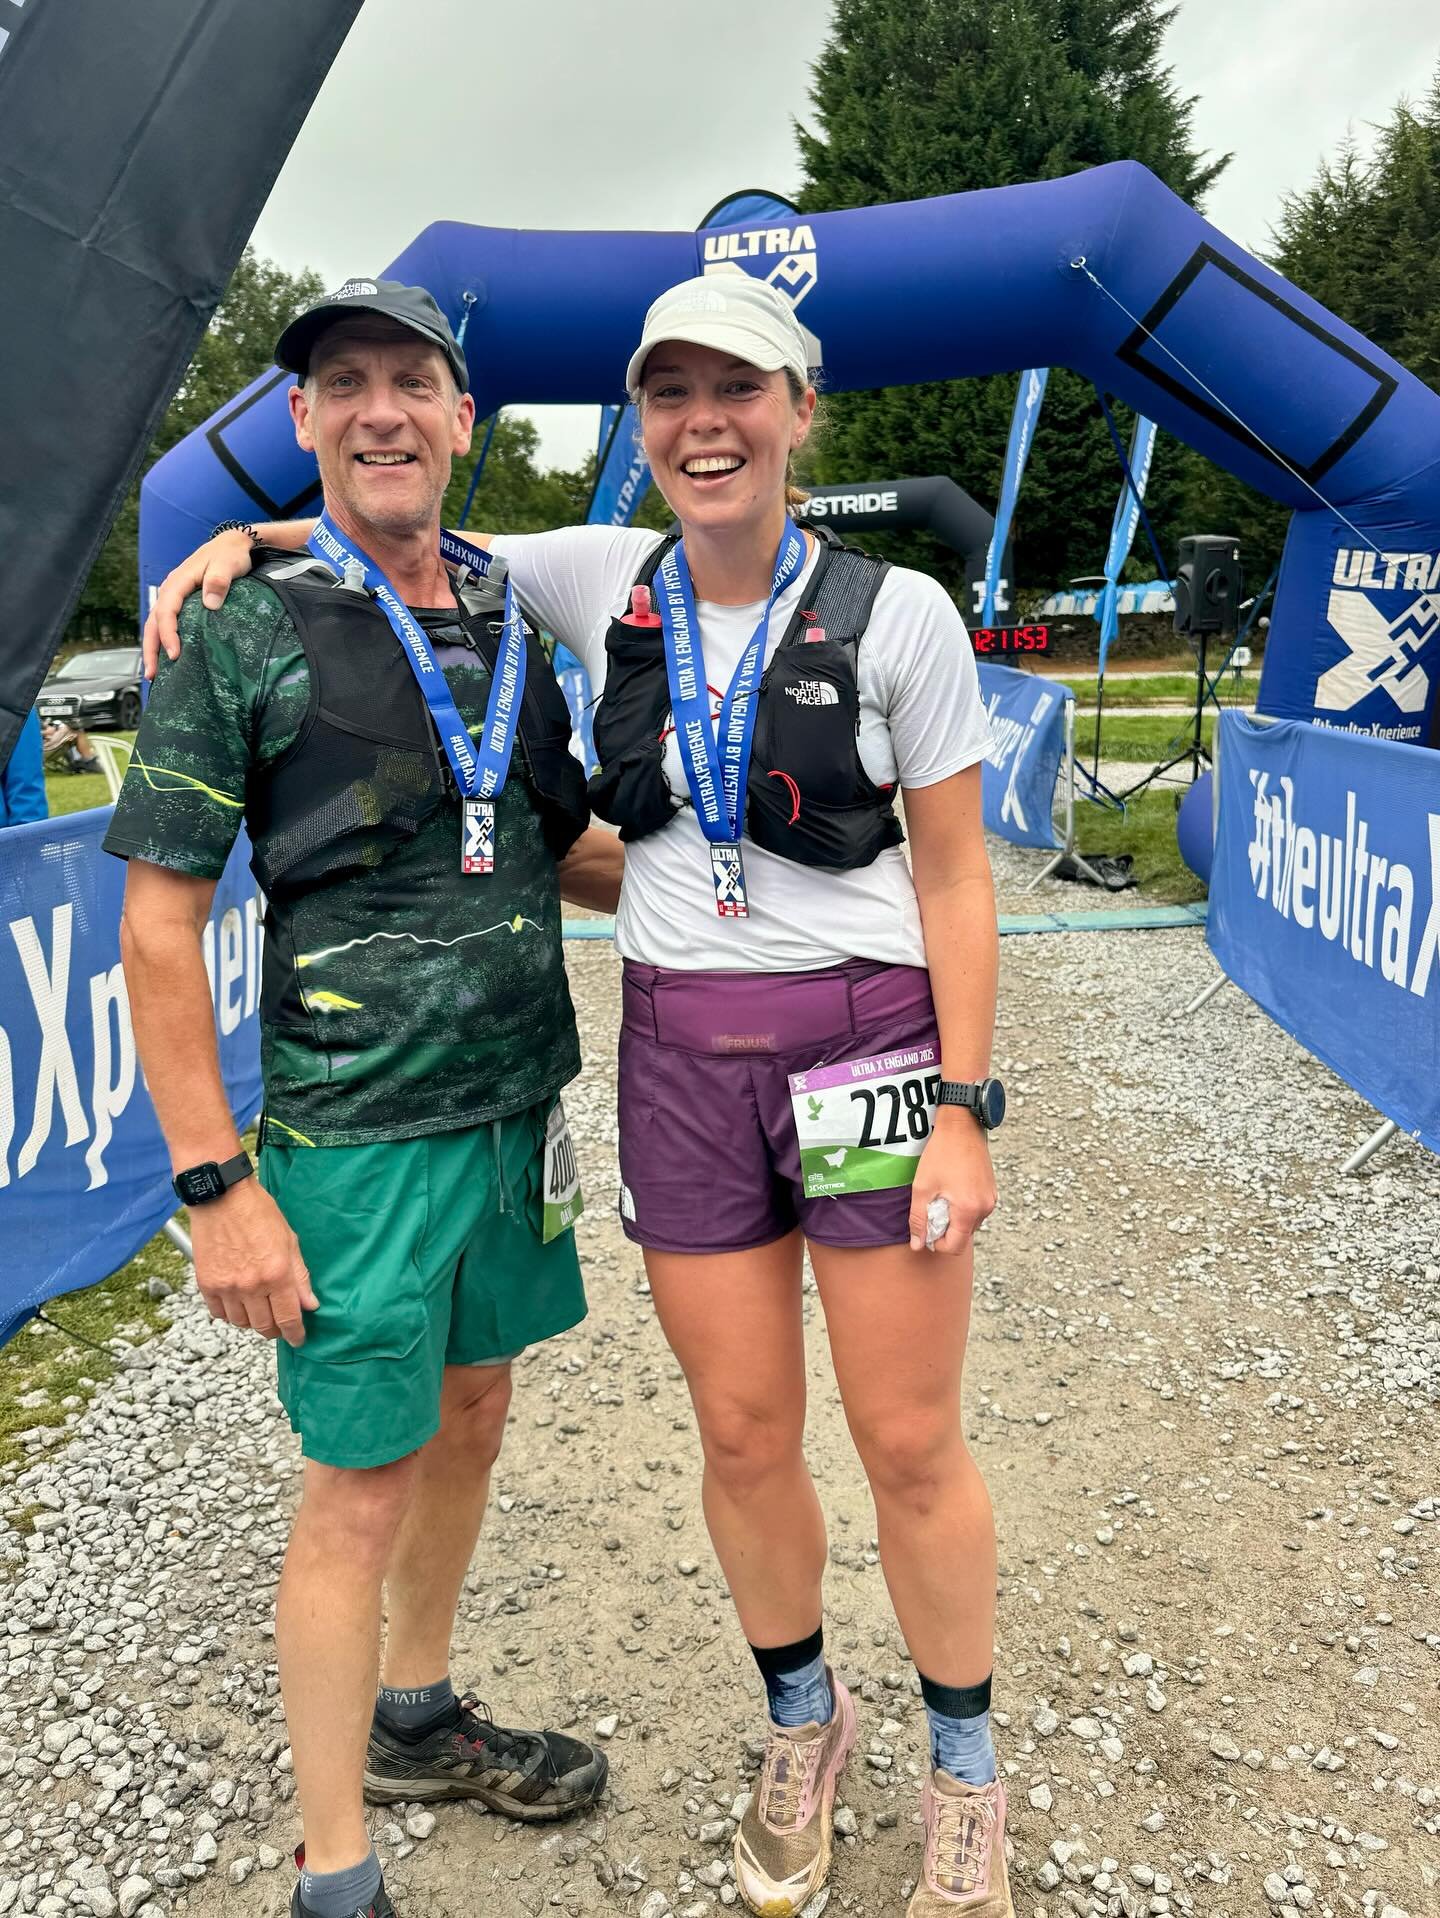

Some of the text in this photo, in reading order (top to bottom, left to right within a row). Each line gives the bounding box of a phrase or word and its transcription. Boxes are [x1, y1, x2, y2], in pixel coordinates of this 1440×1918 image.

[704, 225, 817, 261] ULTRA
[799, 491, 898, 517] YSTRIDE
[667, 592, 686, 606] BY
[373, 584, 435, 674] #ULTRAXPERIENCE
[671, 607, 696, 655] ENGLAND
[974, 625, 1048, 653] 12:11:53
[505, 648, 519, 668] BY
[677, 656, 693, 667] X
[741, 643, 760, 677] ULTRA
[497, 664, 518, 713] ENGLAND
[679, 667, 698, 702] ULTRA
[737, 679, 753, 688] X
[784, 687, 820, 697] NORTH
[798, 680, 819, 690] THE
[796, 696, 821, 706] FACE
[495, 710, 510, 722] X
[489, 720, 508, 754] ULTRA
[725, 745, 742, 762] BY
[686, 718, 720, 824] #ULTRAXPERIENCE
[466, 803, 494, 817] ULTRA
[711, 848, 740, 861] ULTRA
[851, 1048, 935, 1077] ULTRA X ENGLAND 2025
